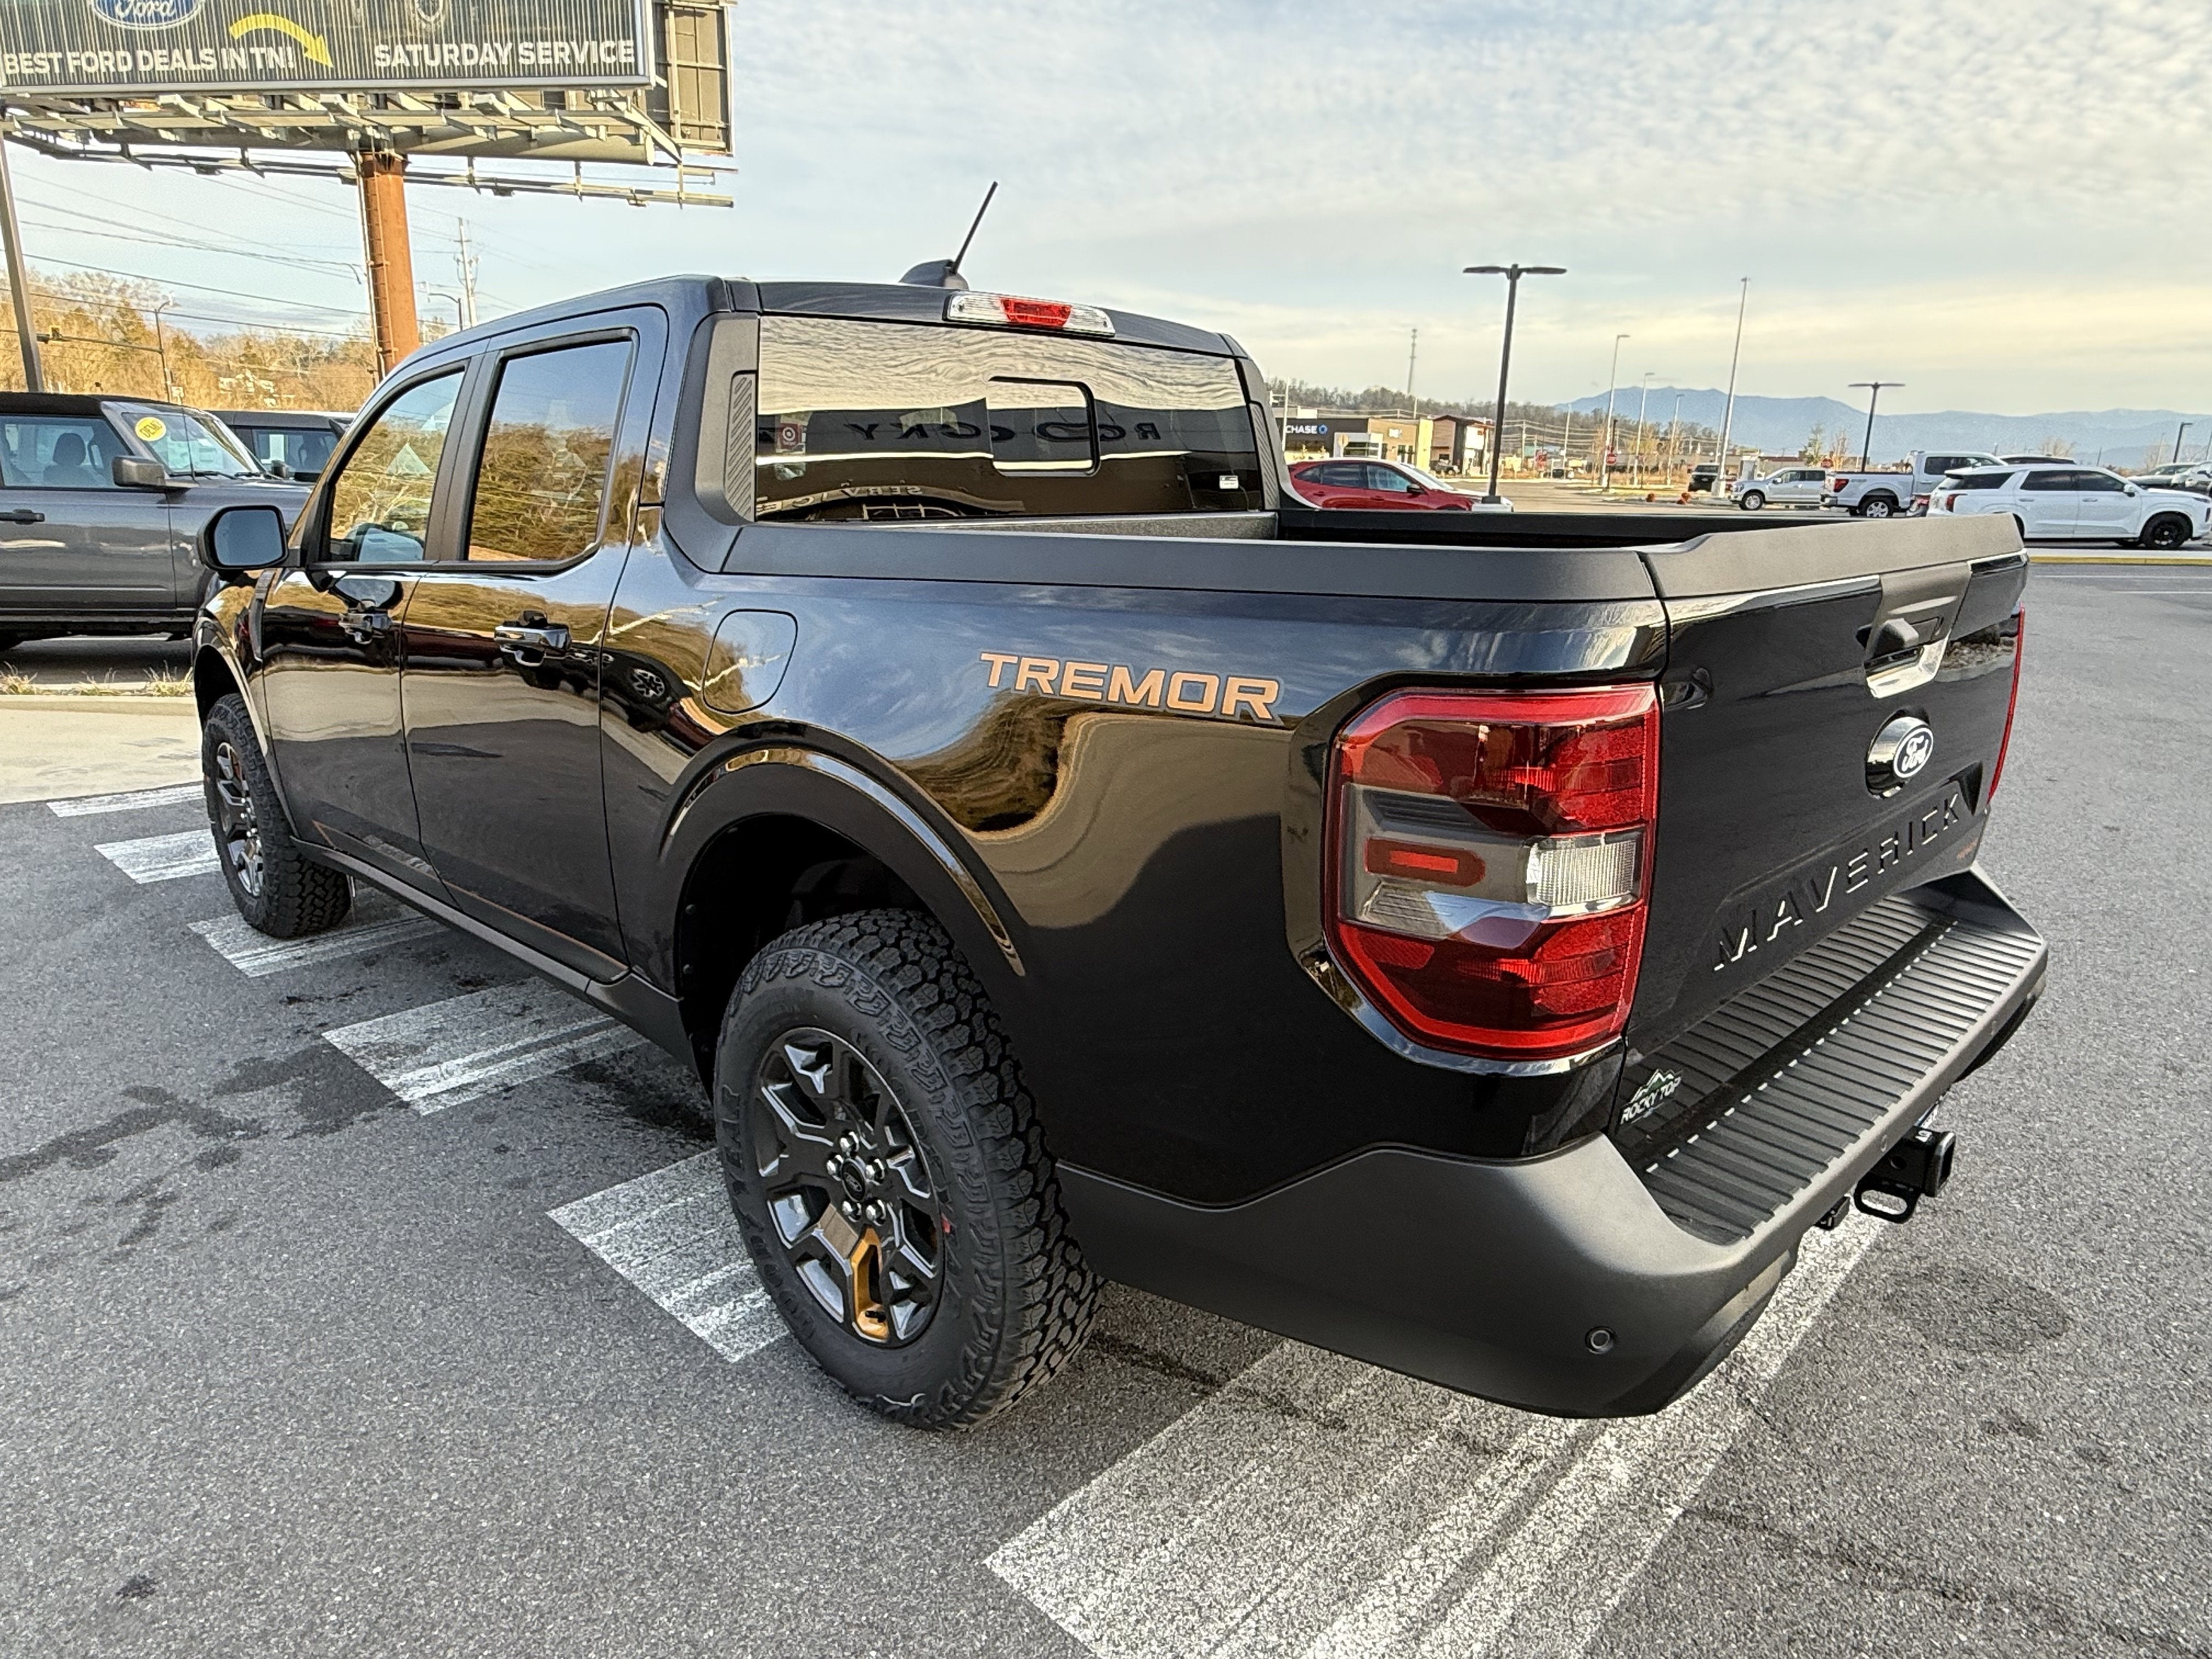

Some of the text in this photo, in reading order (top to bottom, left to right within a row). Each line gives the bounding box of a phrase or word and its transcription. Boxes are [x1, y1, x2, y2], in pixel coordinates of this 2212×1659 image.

[4, 46, 294, 75] BEST FORD DEALS IN TN!
[374, 39, 635, 68] SATURDAY SERVICE
[1285, 425, 1318, 434] CHASE
[980, 652, 1284, 724] TREMOR
[1901, 735, 1929, 772] Ford
[1713, 793, 1959, 972] MAVERICK
